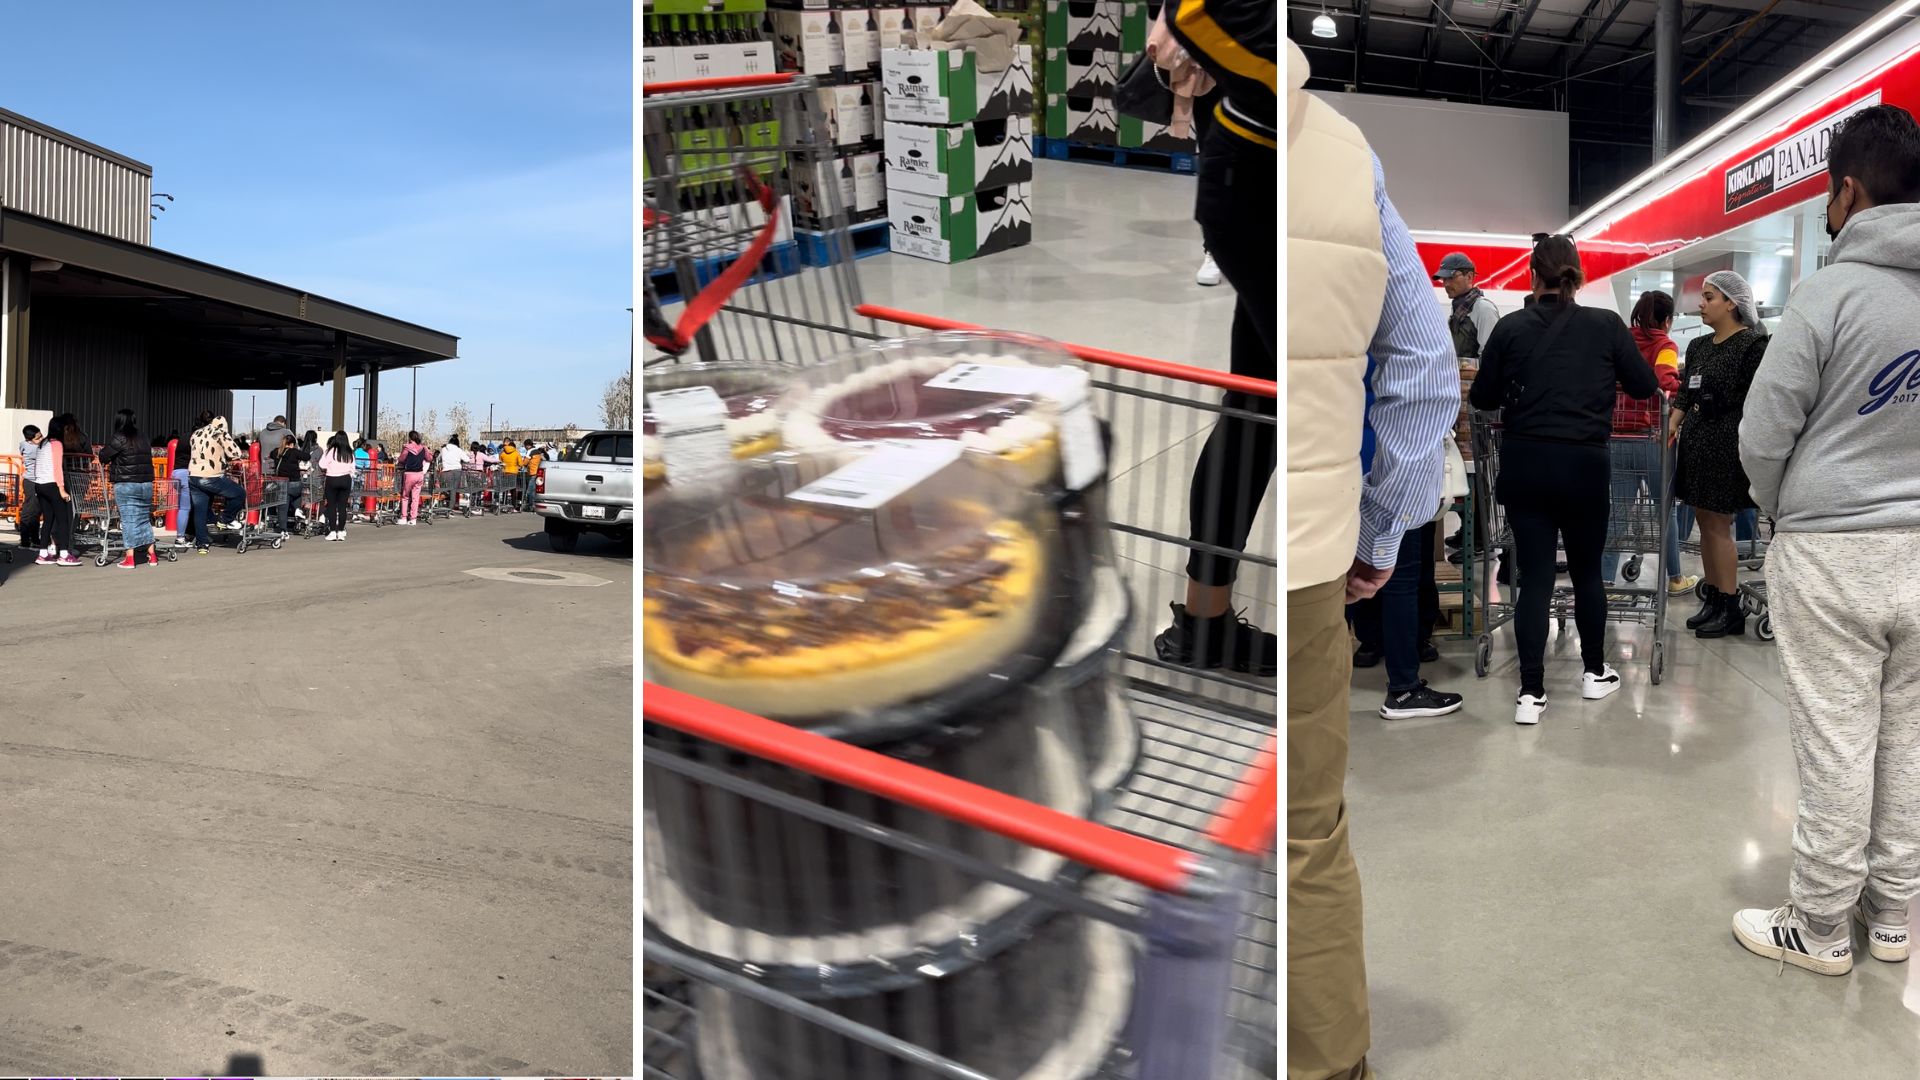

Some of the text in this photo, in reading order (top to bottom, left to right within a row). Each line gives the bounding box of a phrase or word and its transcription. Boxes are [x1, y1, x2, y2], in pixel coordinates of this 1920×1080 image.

[1778, 122, 1841, 181] PANAD
[1728, 155, 1773, 195] KIRKLAND
[1728, 182, 1772, 209] Signature
[1892, 393, 1919, 405] 2017
[1874, 931, 1907, 943] adidas
